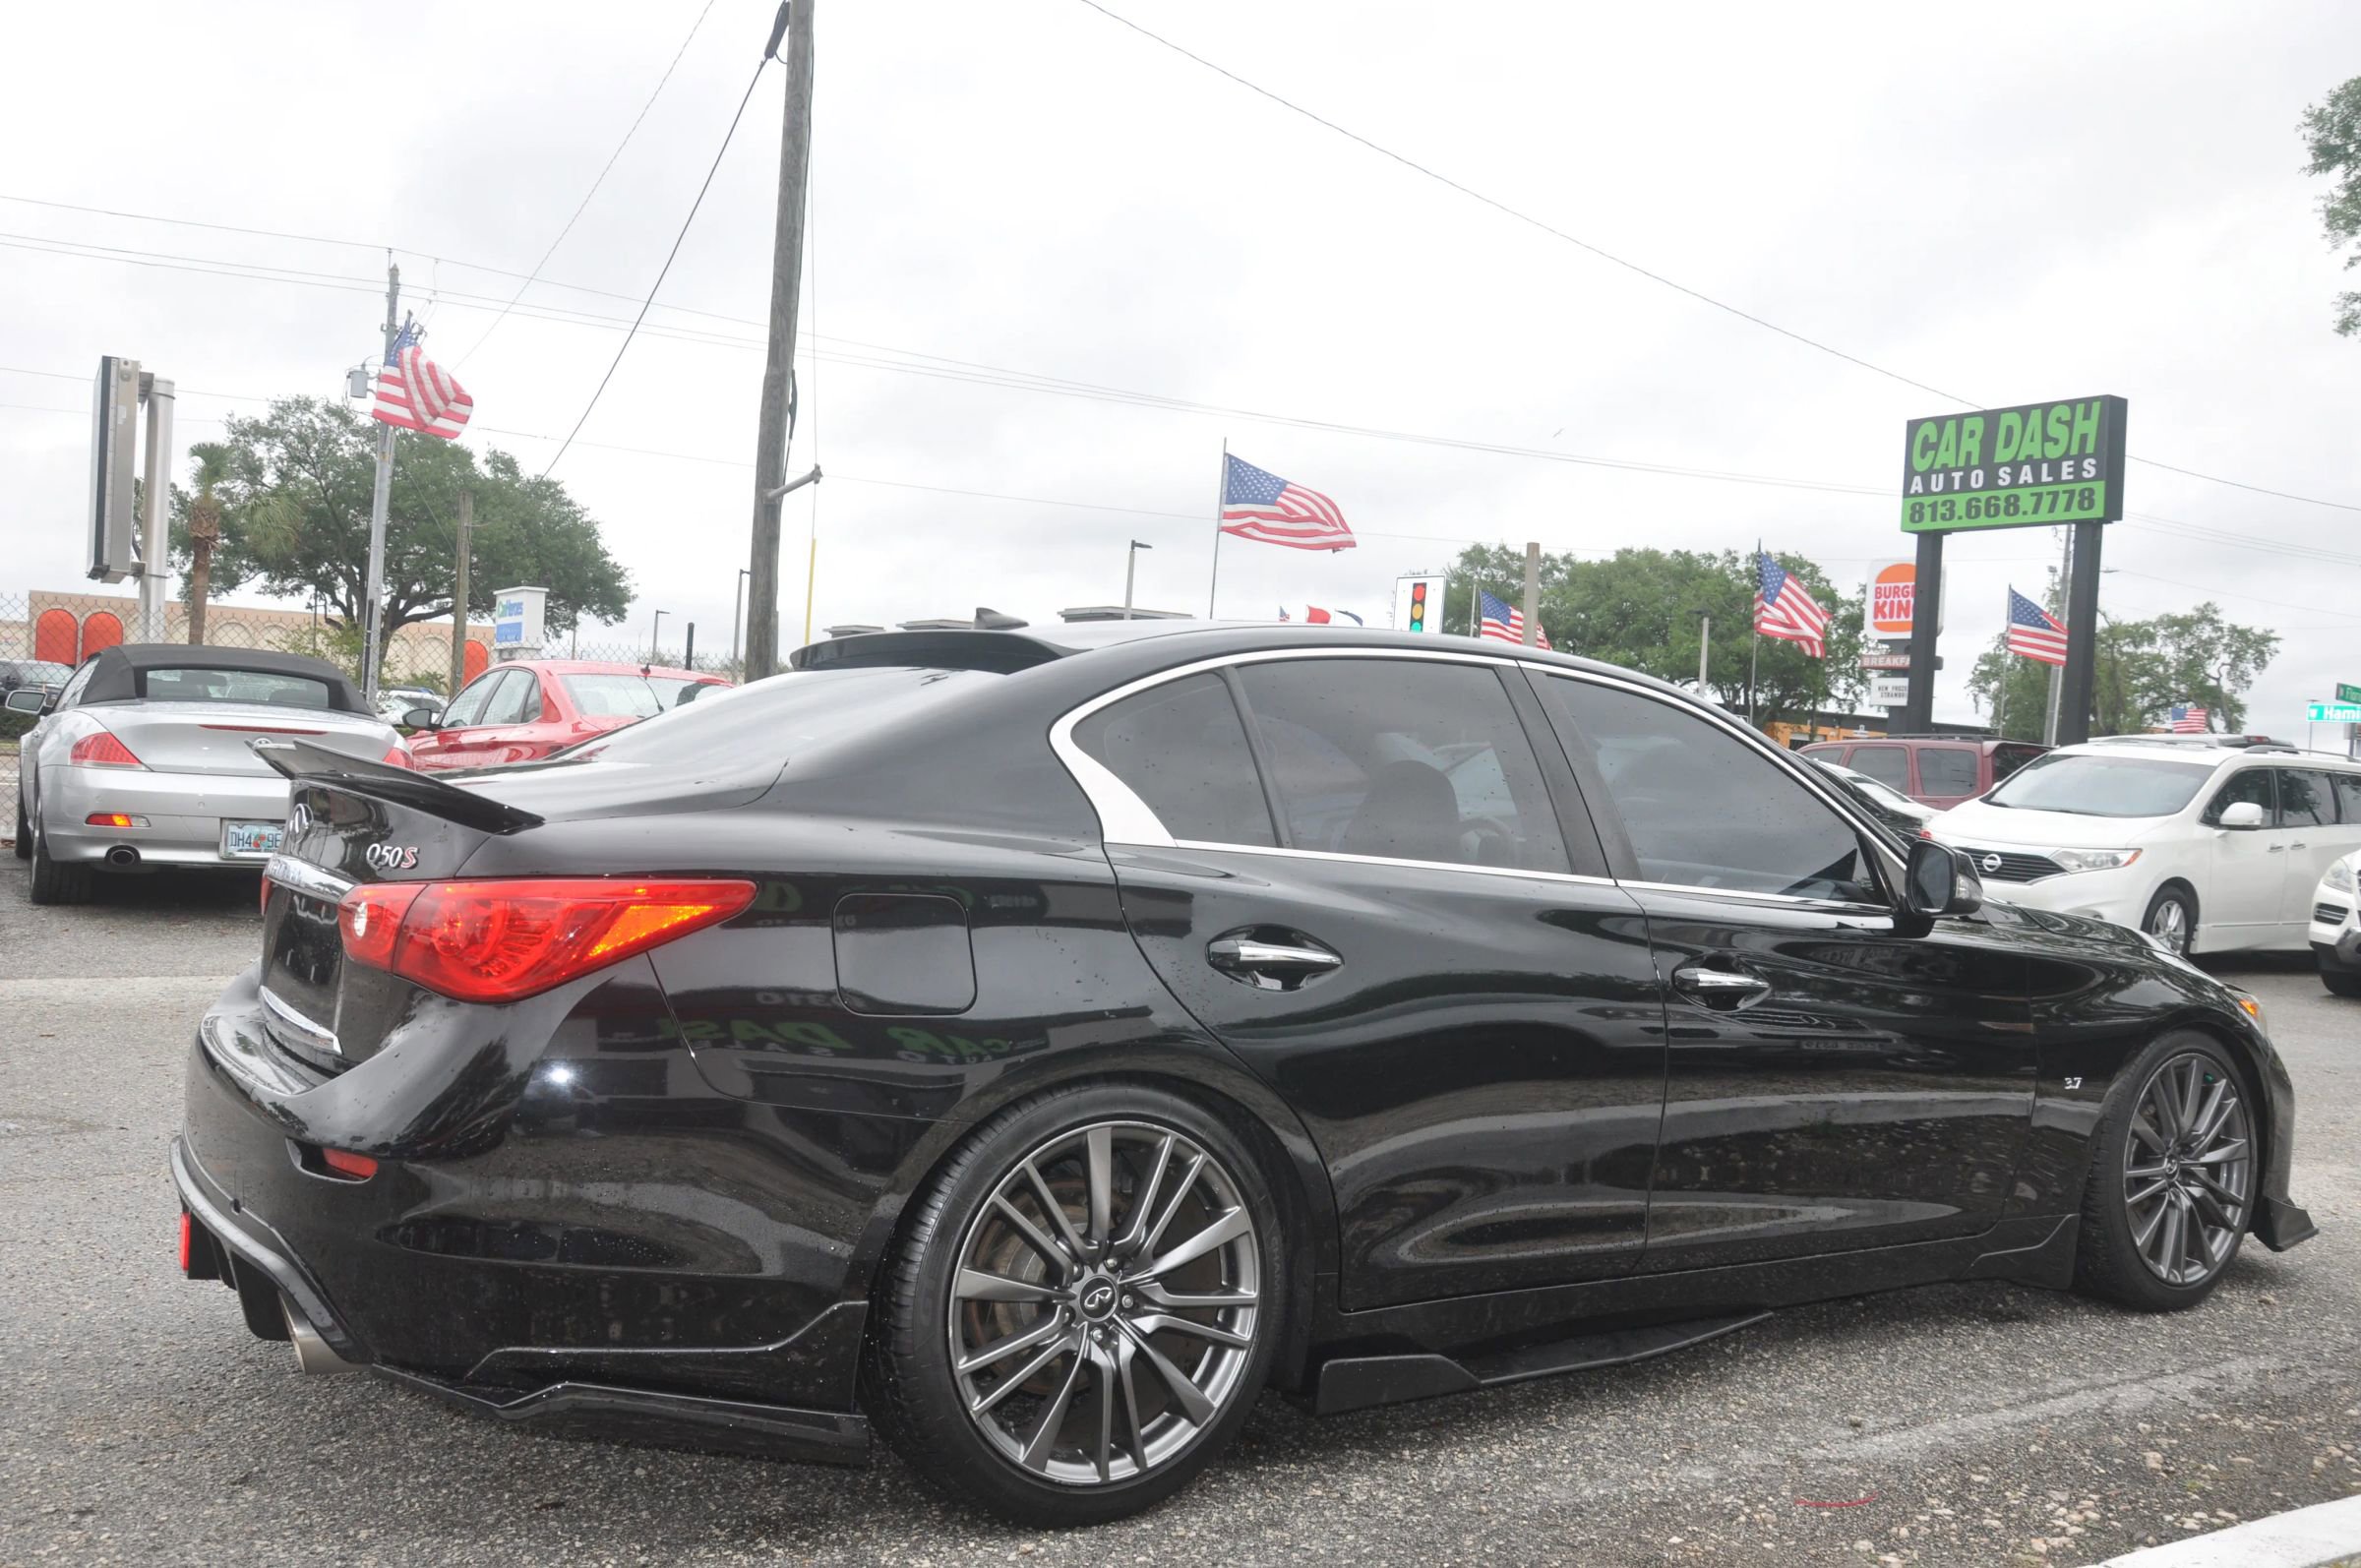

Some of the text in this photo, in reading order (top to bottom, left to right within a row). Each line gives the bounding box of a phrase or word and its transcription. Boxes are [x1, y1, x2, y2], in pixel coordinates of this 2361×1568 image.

[1911, 401, 2101, 472] CAR DASH
[1909, 458, 2097, 494] AUTO SALES
[1908, 487, 2095, 524] 813.668.7778
[1873, 600, 1912, 620] KIN
[366, 843, 420, 869] Q50S
